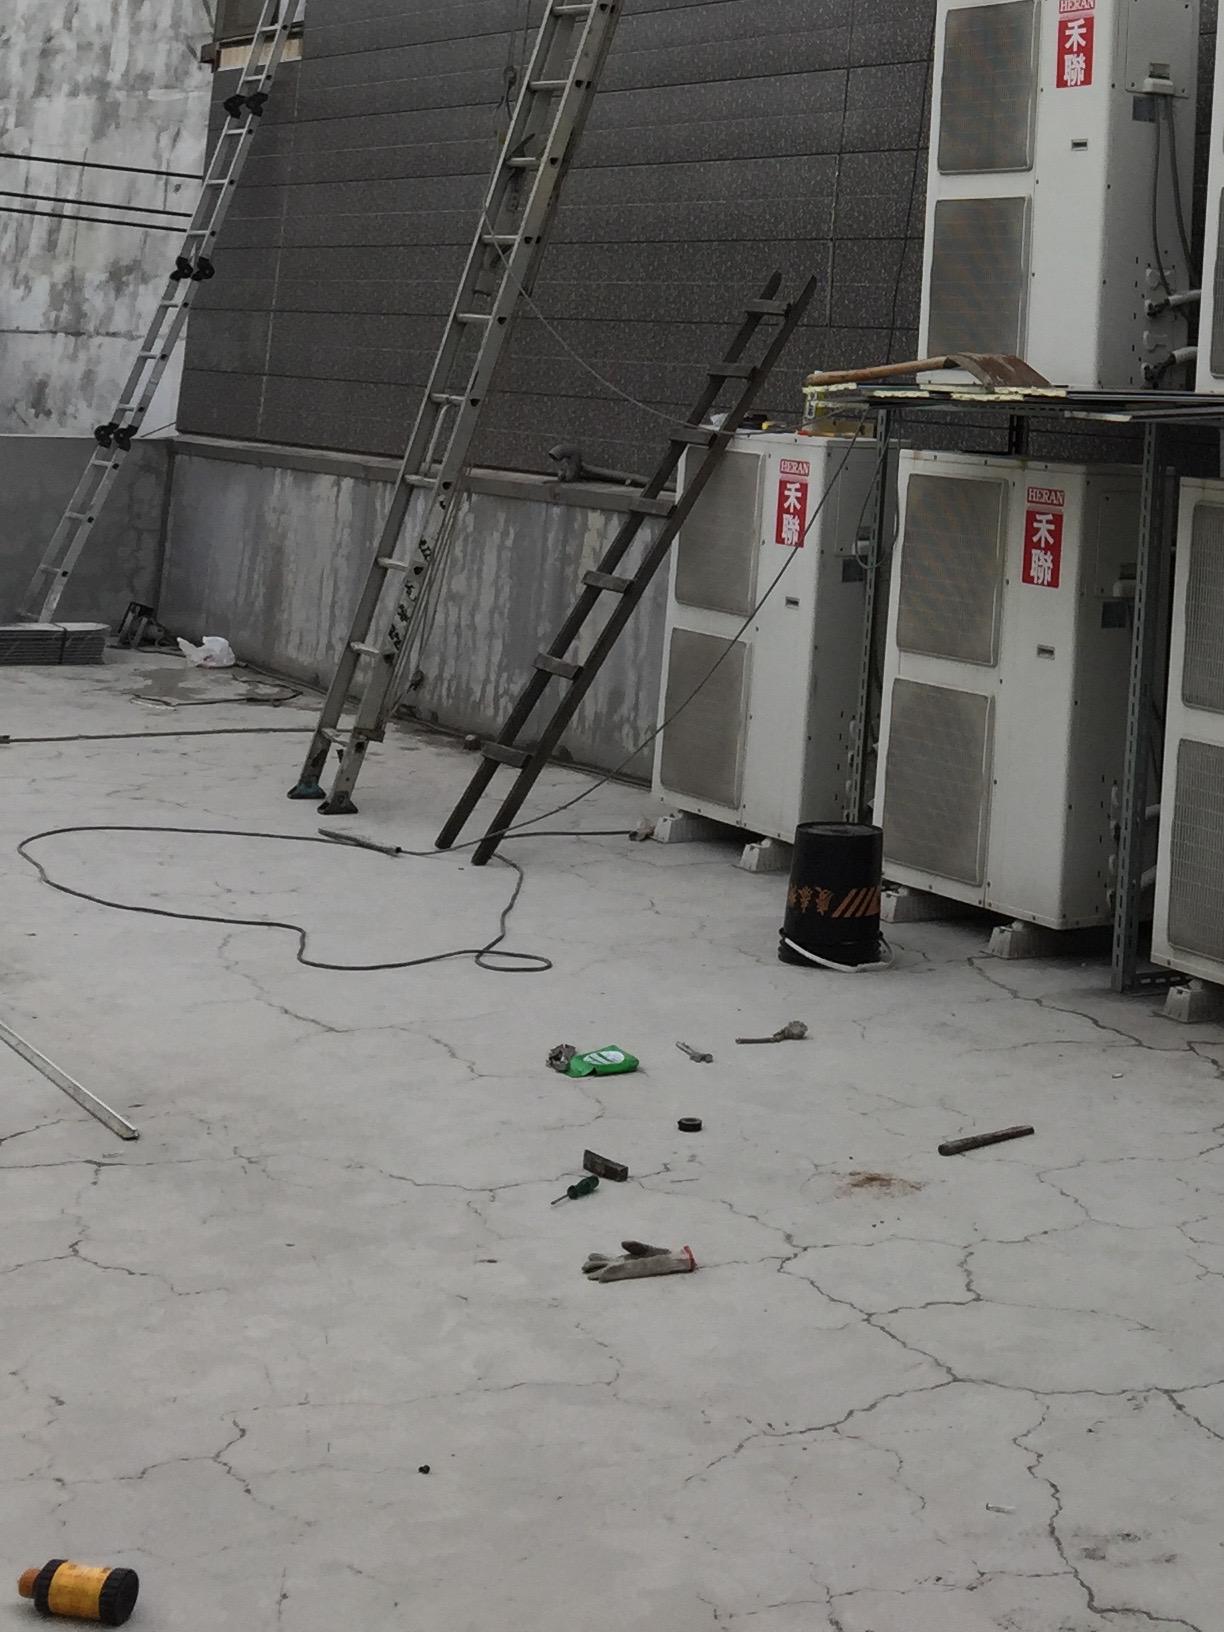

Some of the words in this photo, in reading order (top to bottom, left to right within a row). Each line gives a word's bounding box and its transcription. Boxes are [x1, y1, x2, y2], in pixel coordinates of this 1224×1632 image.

[1064, 20, 1086, 86] 禾聯
[781, 461, 809, 474] HERAN
[1028, 489, 1064, 504] HERAN
[782, 482, 802, 545] 禾聯
[1031, 513, 1055, 586] 禾聯
